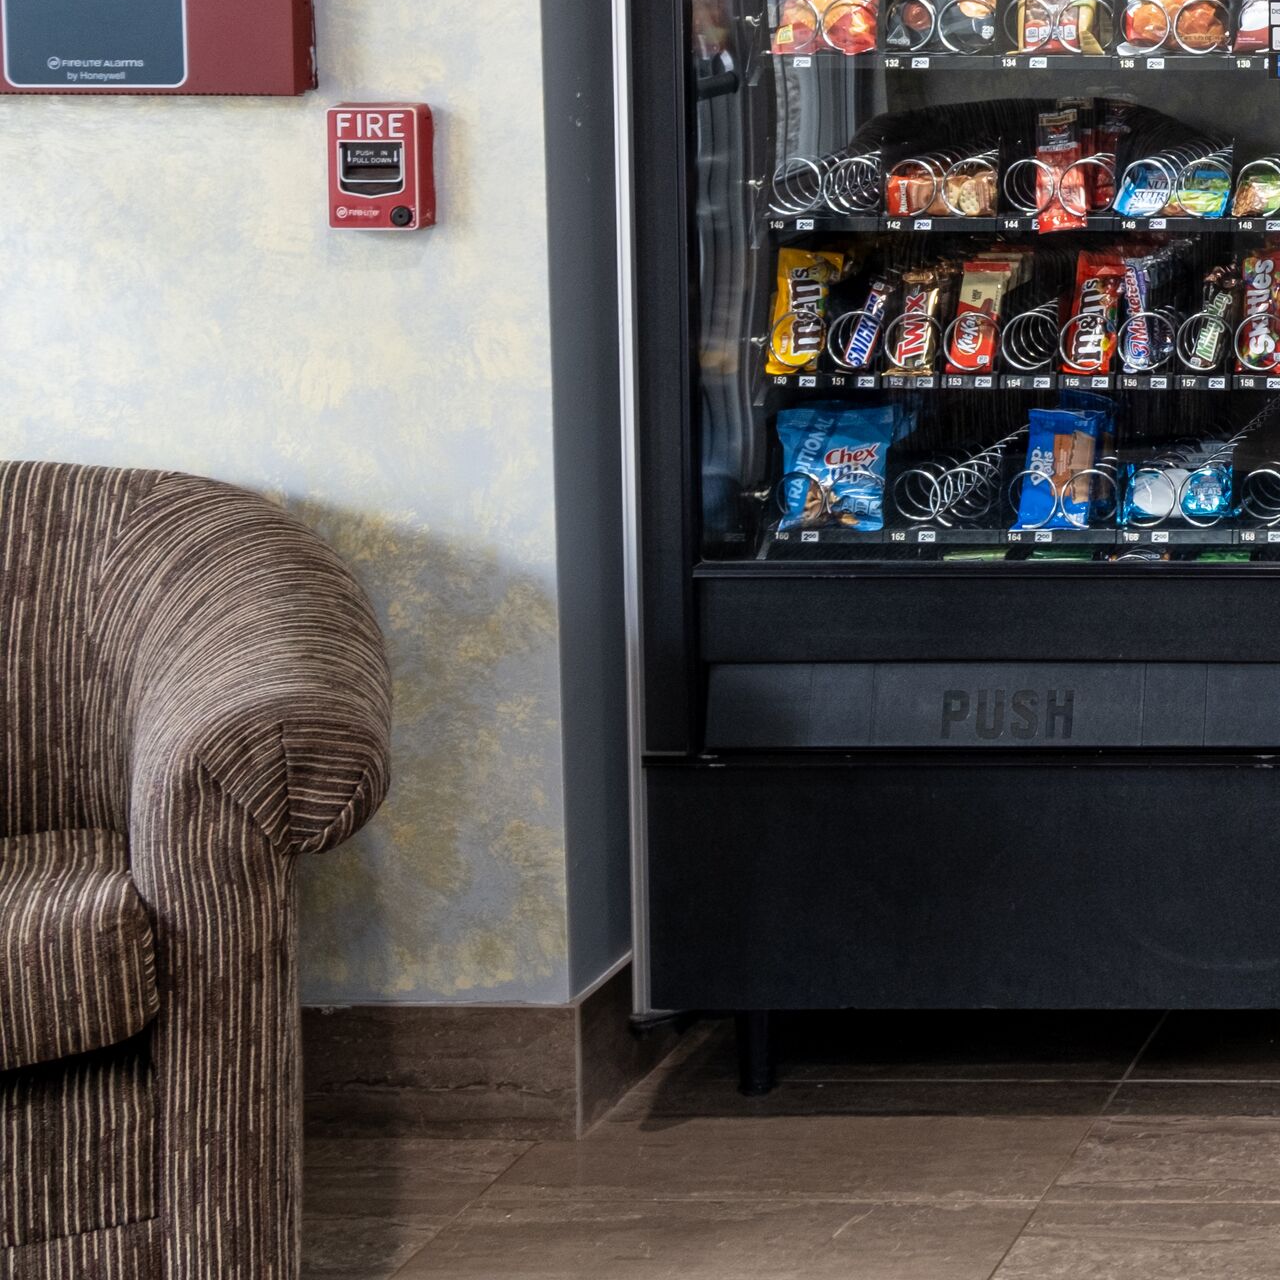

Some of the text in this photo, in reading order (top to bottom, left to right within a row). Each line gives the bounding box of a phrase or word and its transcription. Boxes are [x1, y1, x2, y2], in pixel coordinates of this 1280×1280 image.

[885, 59, 899, 67] 132
[1002, 59, 1016, 67] 134
[67, 72, 125, 81] by Honeywell
[336, 114, 405, 138] FIRE
[770, 221, 784, 229] 140
[886, 221, 900, 229] 142
[1004, 221, 1019, 229] 144
[1247, 259, 1275, 355] Skittles
[846, 292, 885, 366] SNICKERS
[898, 292, 928, 366] TWIX
[773, 377, 787, 385] 150
[832, 377, 845, 385] 151
[1006, 379, 1021, 388] 154
[1065, 378, 1079, 386] 155
[1182, 379, 1196, 387] 157
[825, 442, 881, 465] Chex
[1193, 486, 1222, 496] TREATS
[891, 532, 905, 540] 162
[1007, 532, 1021, 541] 164
[941, 689, 1075, 739] PUSH
